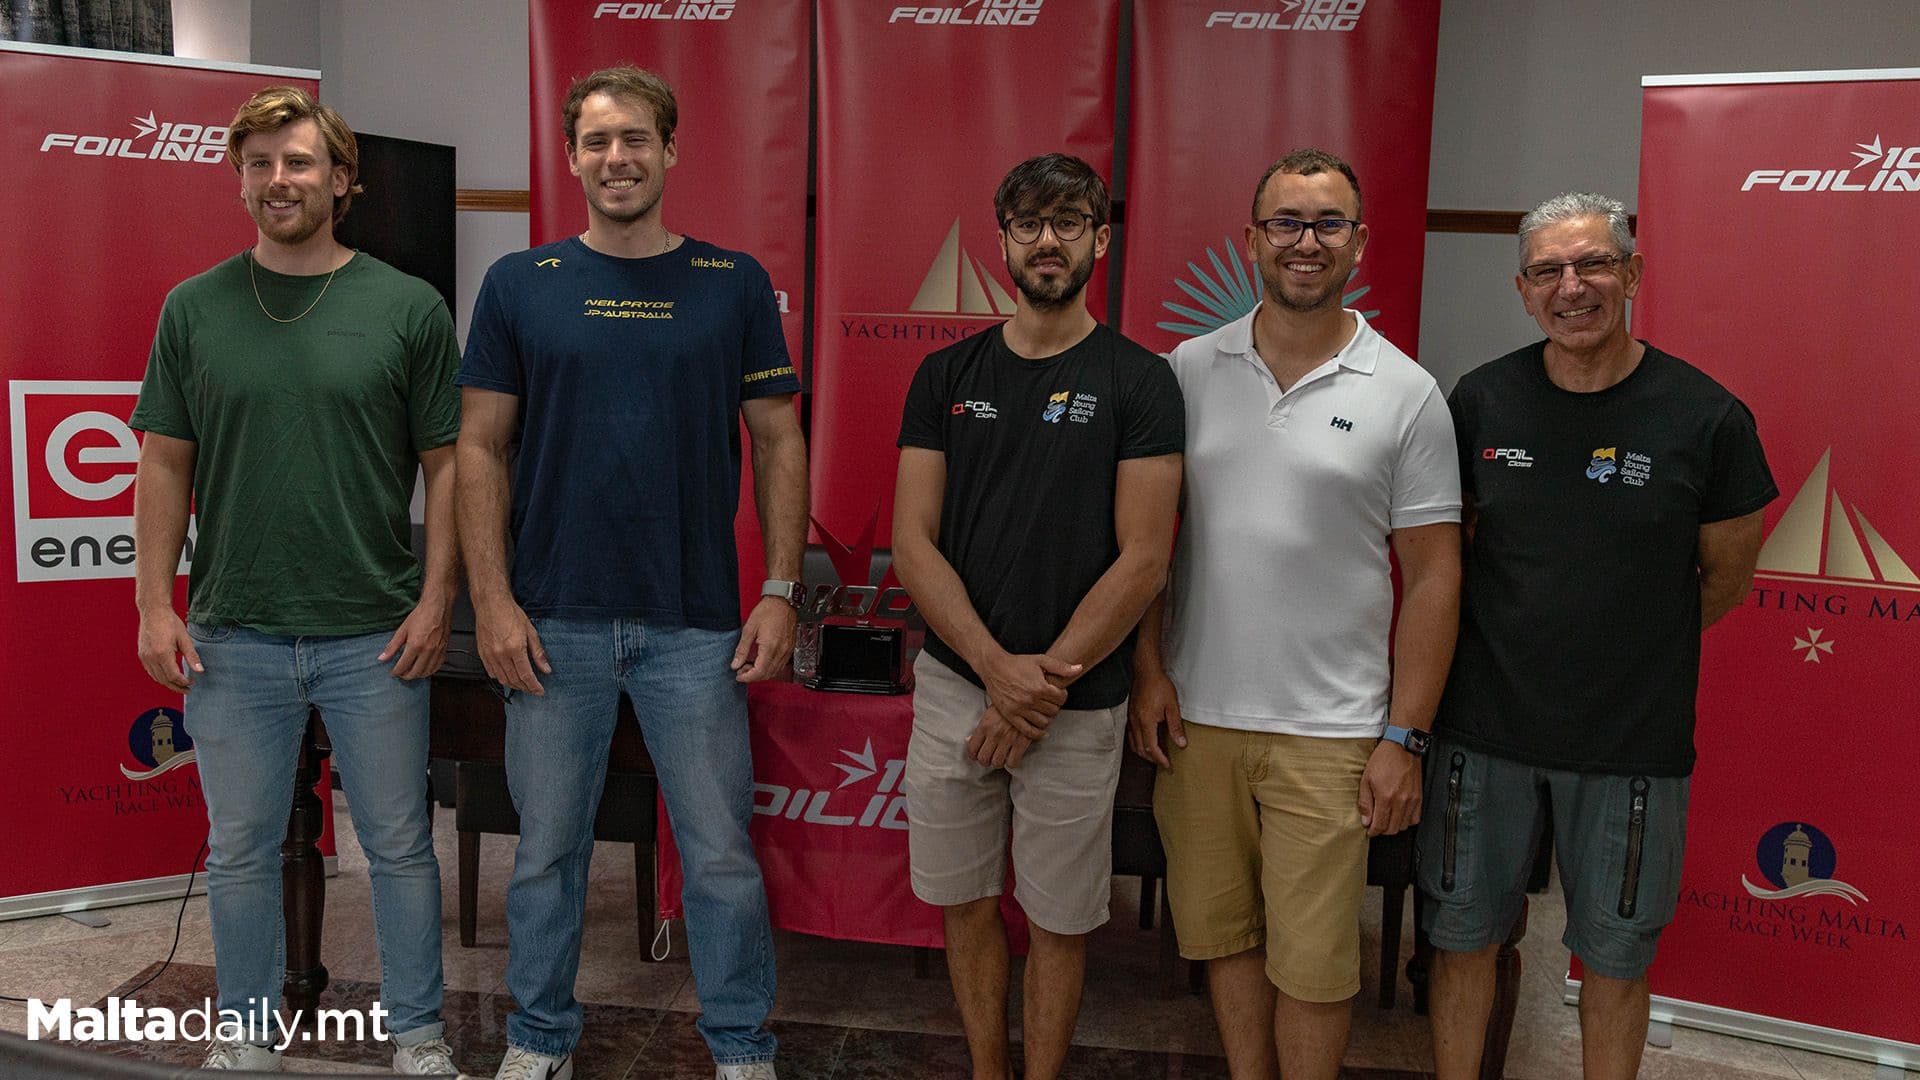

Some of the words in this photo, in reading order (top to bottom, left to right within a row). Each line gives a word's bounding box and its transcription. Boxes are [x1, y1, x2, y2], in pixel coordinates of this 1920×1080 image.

[592, 3, 736, 20] FOILING
[888, 7, 1041, 26] FOILING
[1205, 11, 1361, 31] FOILING
[157, 122, 230, 145] 100
[39, 133, 228, 164] FOILING
[690, 257, 735, 269] fritz-kola
[584, 299, 675, 309] NEILPRYDE
[583, 309, 674, 319] JP-AUSTRALIA
[1075, 393, 1098, 403] Malta
[1072, 400, 1097, 410] Young
[1069, 414, 1089, 424] Club
[1330, 416, 1353, 432] HH
[1625, 452, 1651, 464] Malta
[1623, 459, 1651, 472] Young
[1620, 467, 1651, 479] Sailors
[1622, 476, 1645, 487] Club
[58, 777, 177, 804] YACHTING
[1818, 907, 1907, 940] MALTA
[1729, 915, 1783, 938] RACE
[1791, 924, 1850, 949] WEEK
